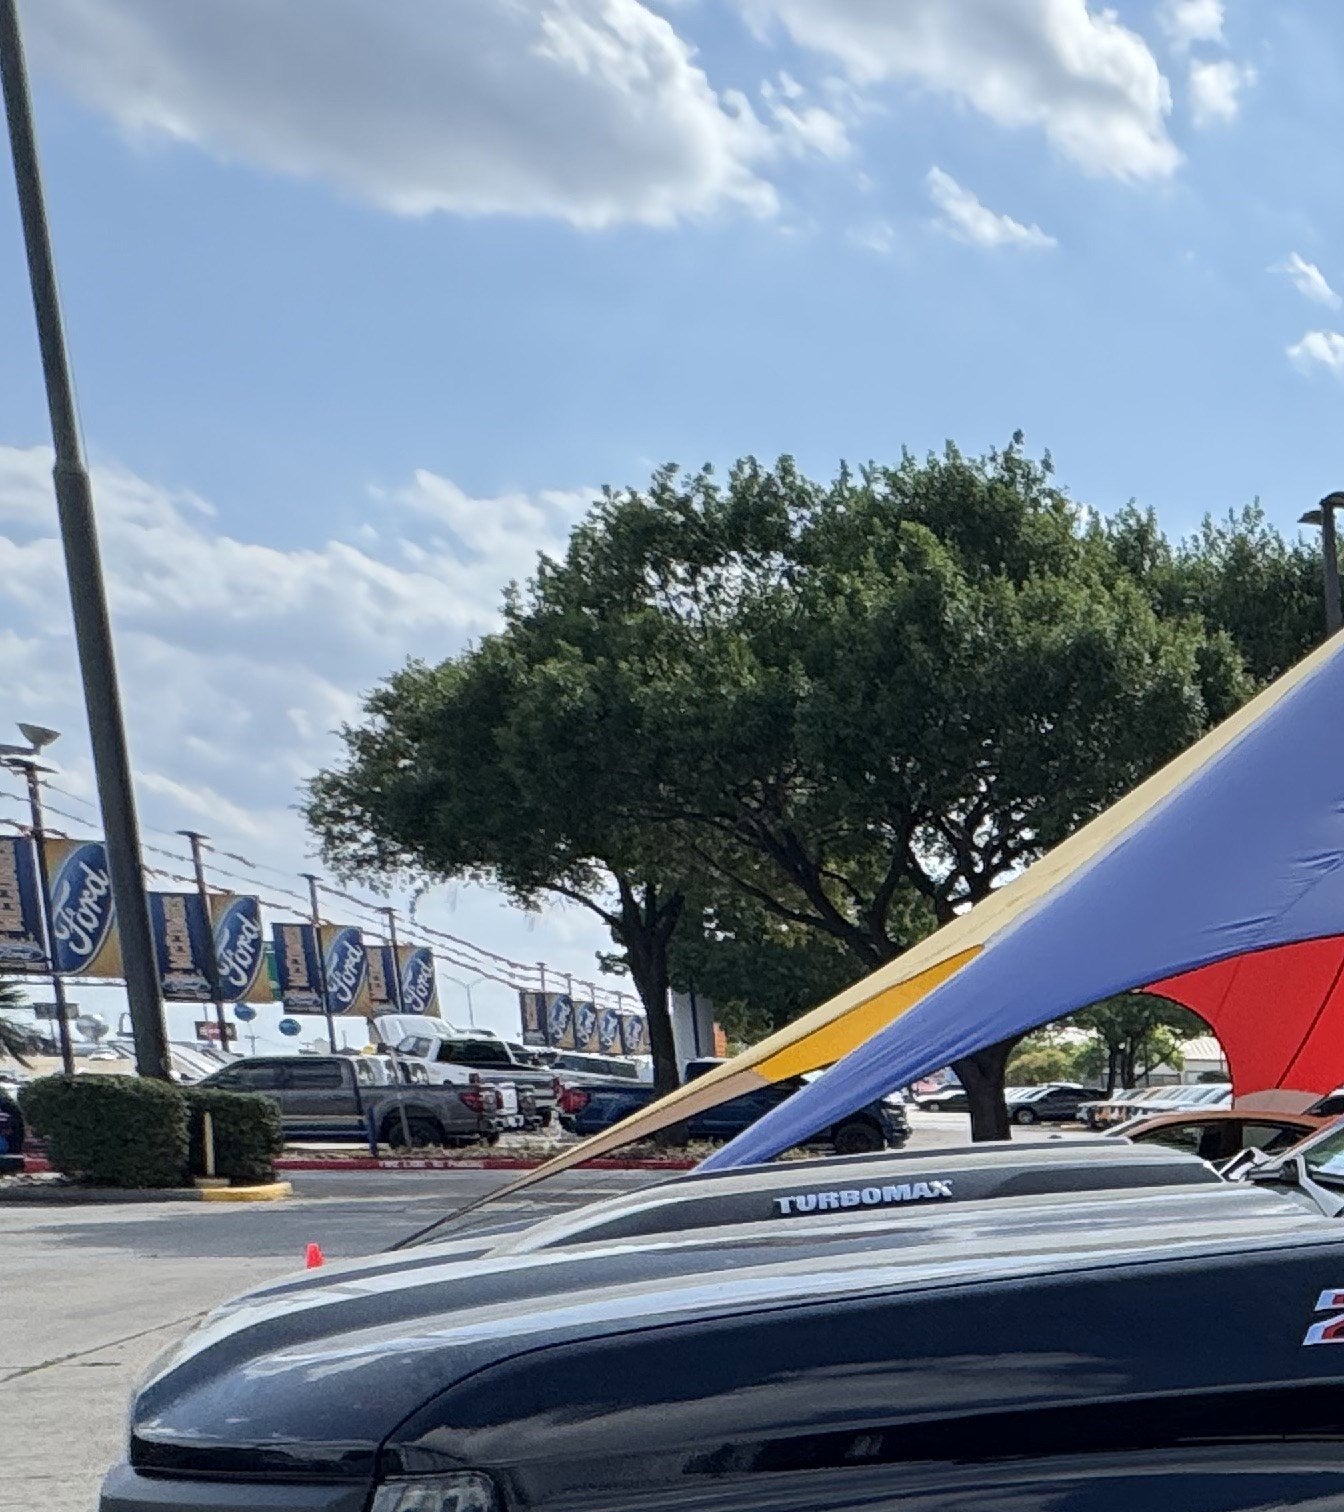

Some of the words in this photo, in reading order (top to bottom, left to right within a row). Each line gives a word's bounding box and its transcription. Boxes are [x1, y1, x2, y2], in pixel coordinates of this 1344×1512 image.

[54, 861, 110, 956] Ford
[217, 912, 260, 986] Ford
[327, 940, 364, 1002] Ford
[403, 957, 432, 1012] Ford
[773, 1179, 954, 1215] TURBOMAX
